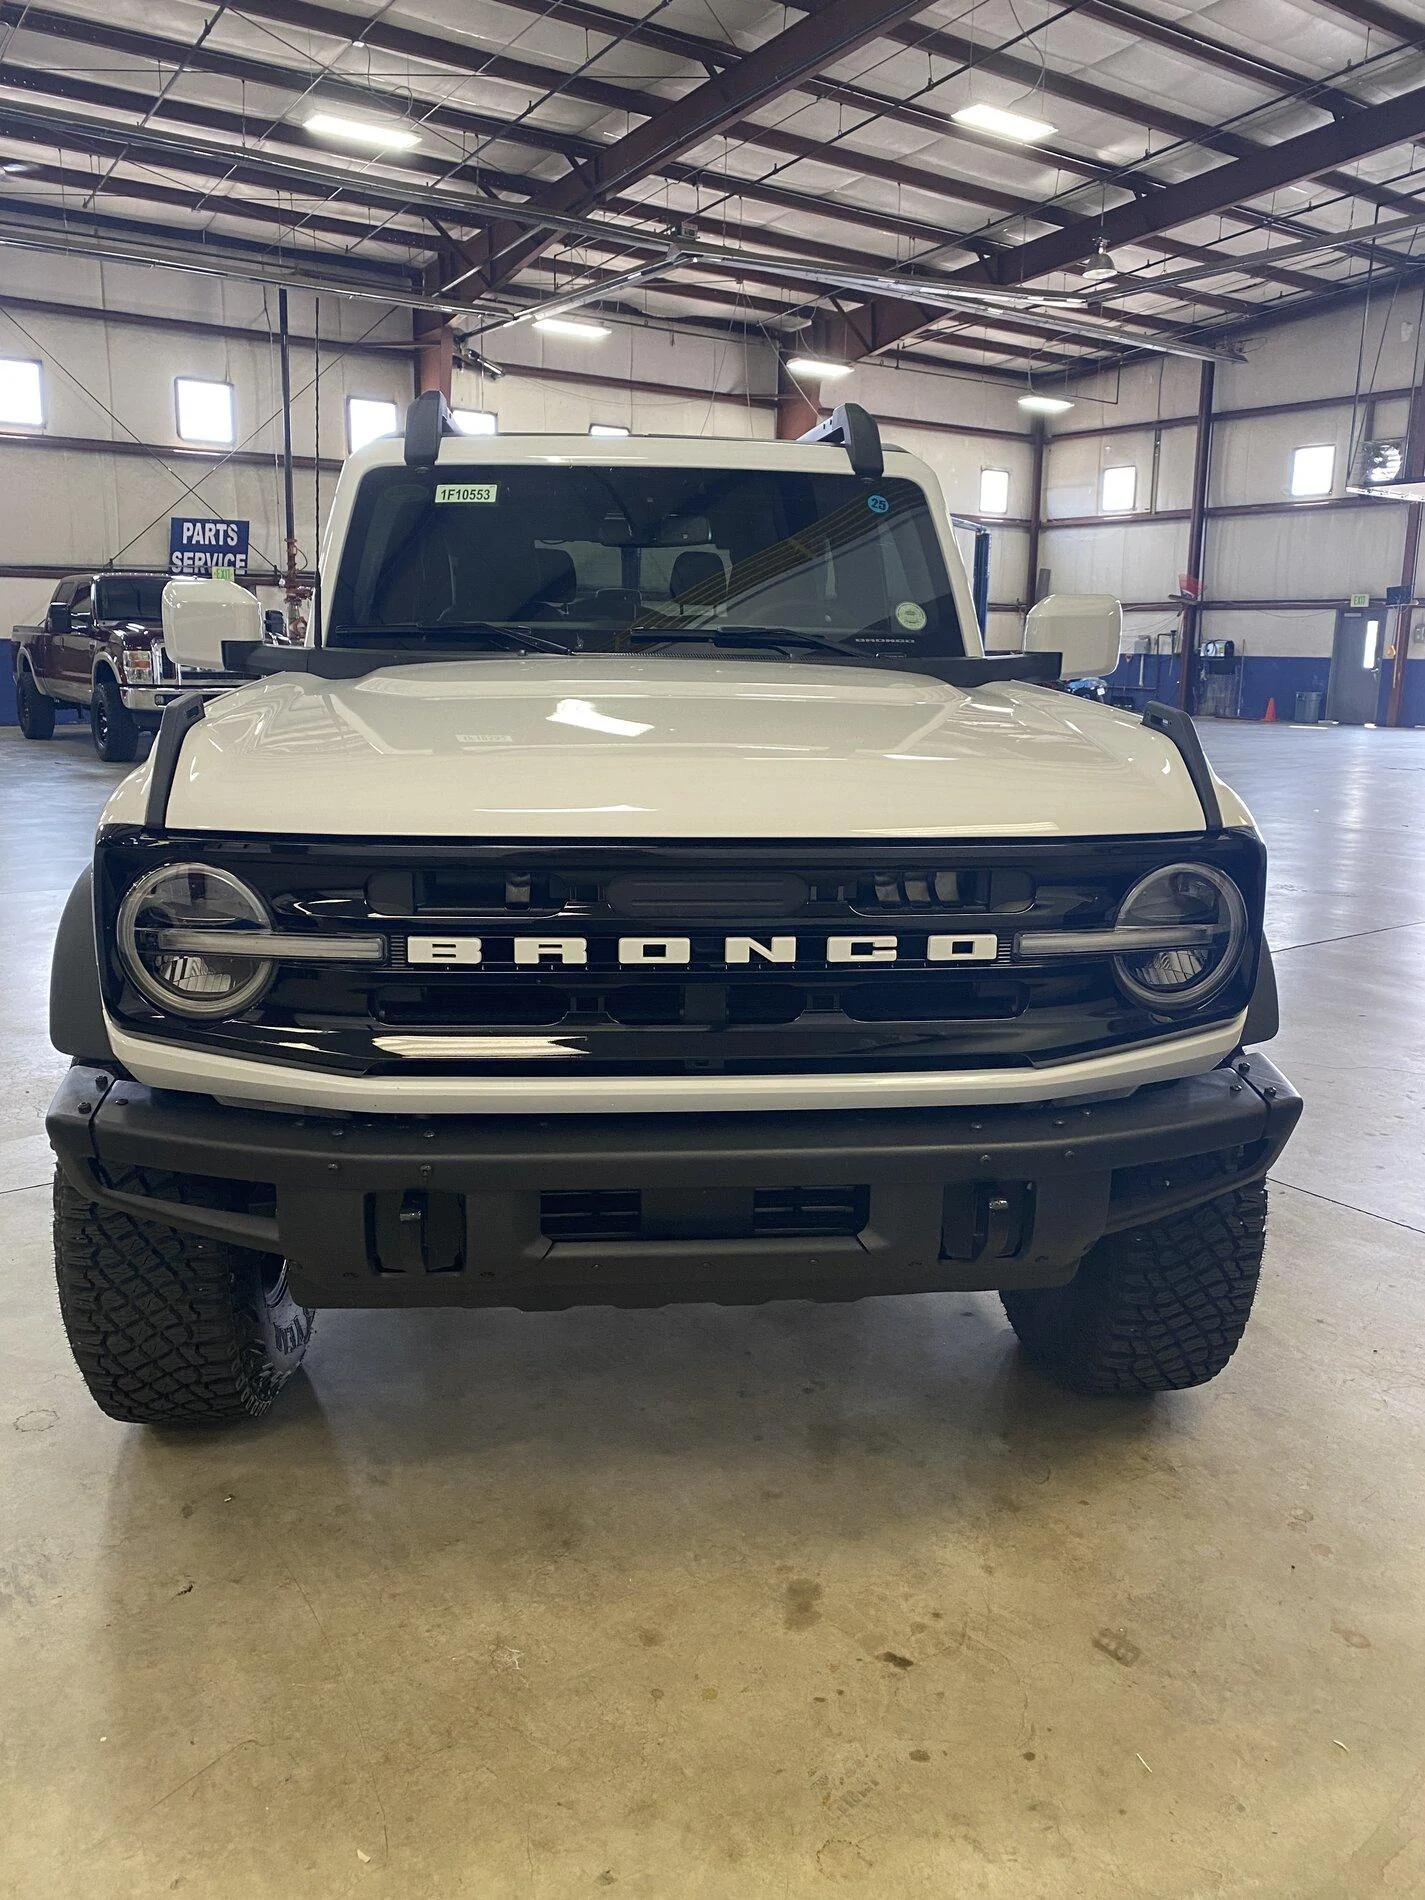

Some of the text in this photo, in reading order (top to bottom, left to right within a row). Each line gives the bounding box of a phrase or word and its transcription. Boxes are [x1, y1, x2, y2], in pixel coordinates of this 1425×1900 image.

[441, 489, 490, 500] 1F10553
[871, 498, 886, 510] 25
[182, 522, 238, 546] PARTS
[171, 551, 247, 575] SERVICE
[216, 568, 231, 580] EXIT
[1353, 595, 1366, 606] EXIT
[407, 934, 998, 965] BRONCO
